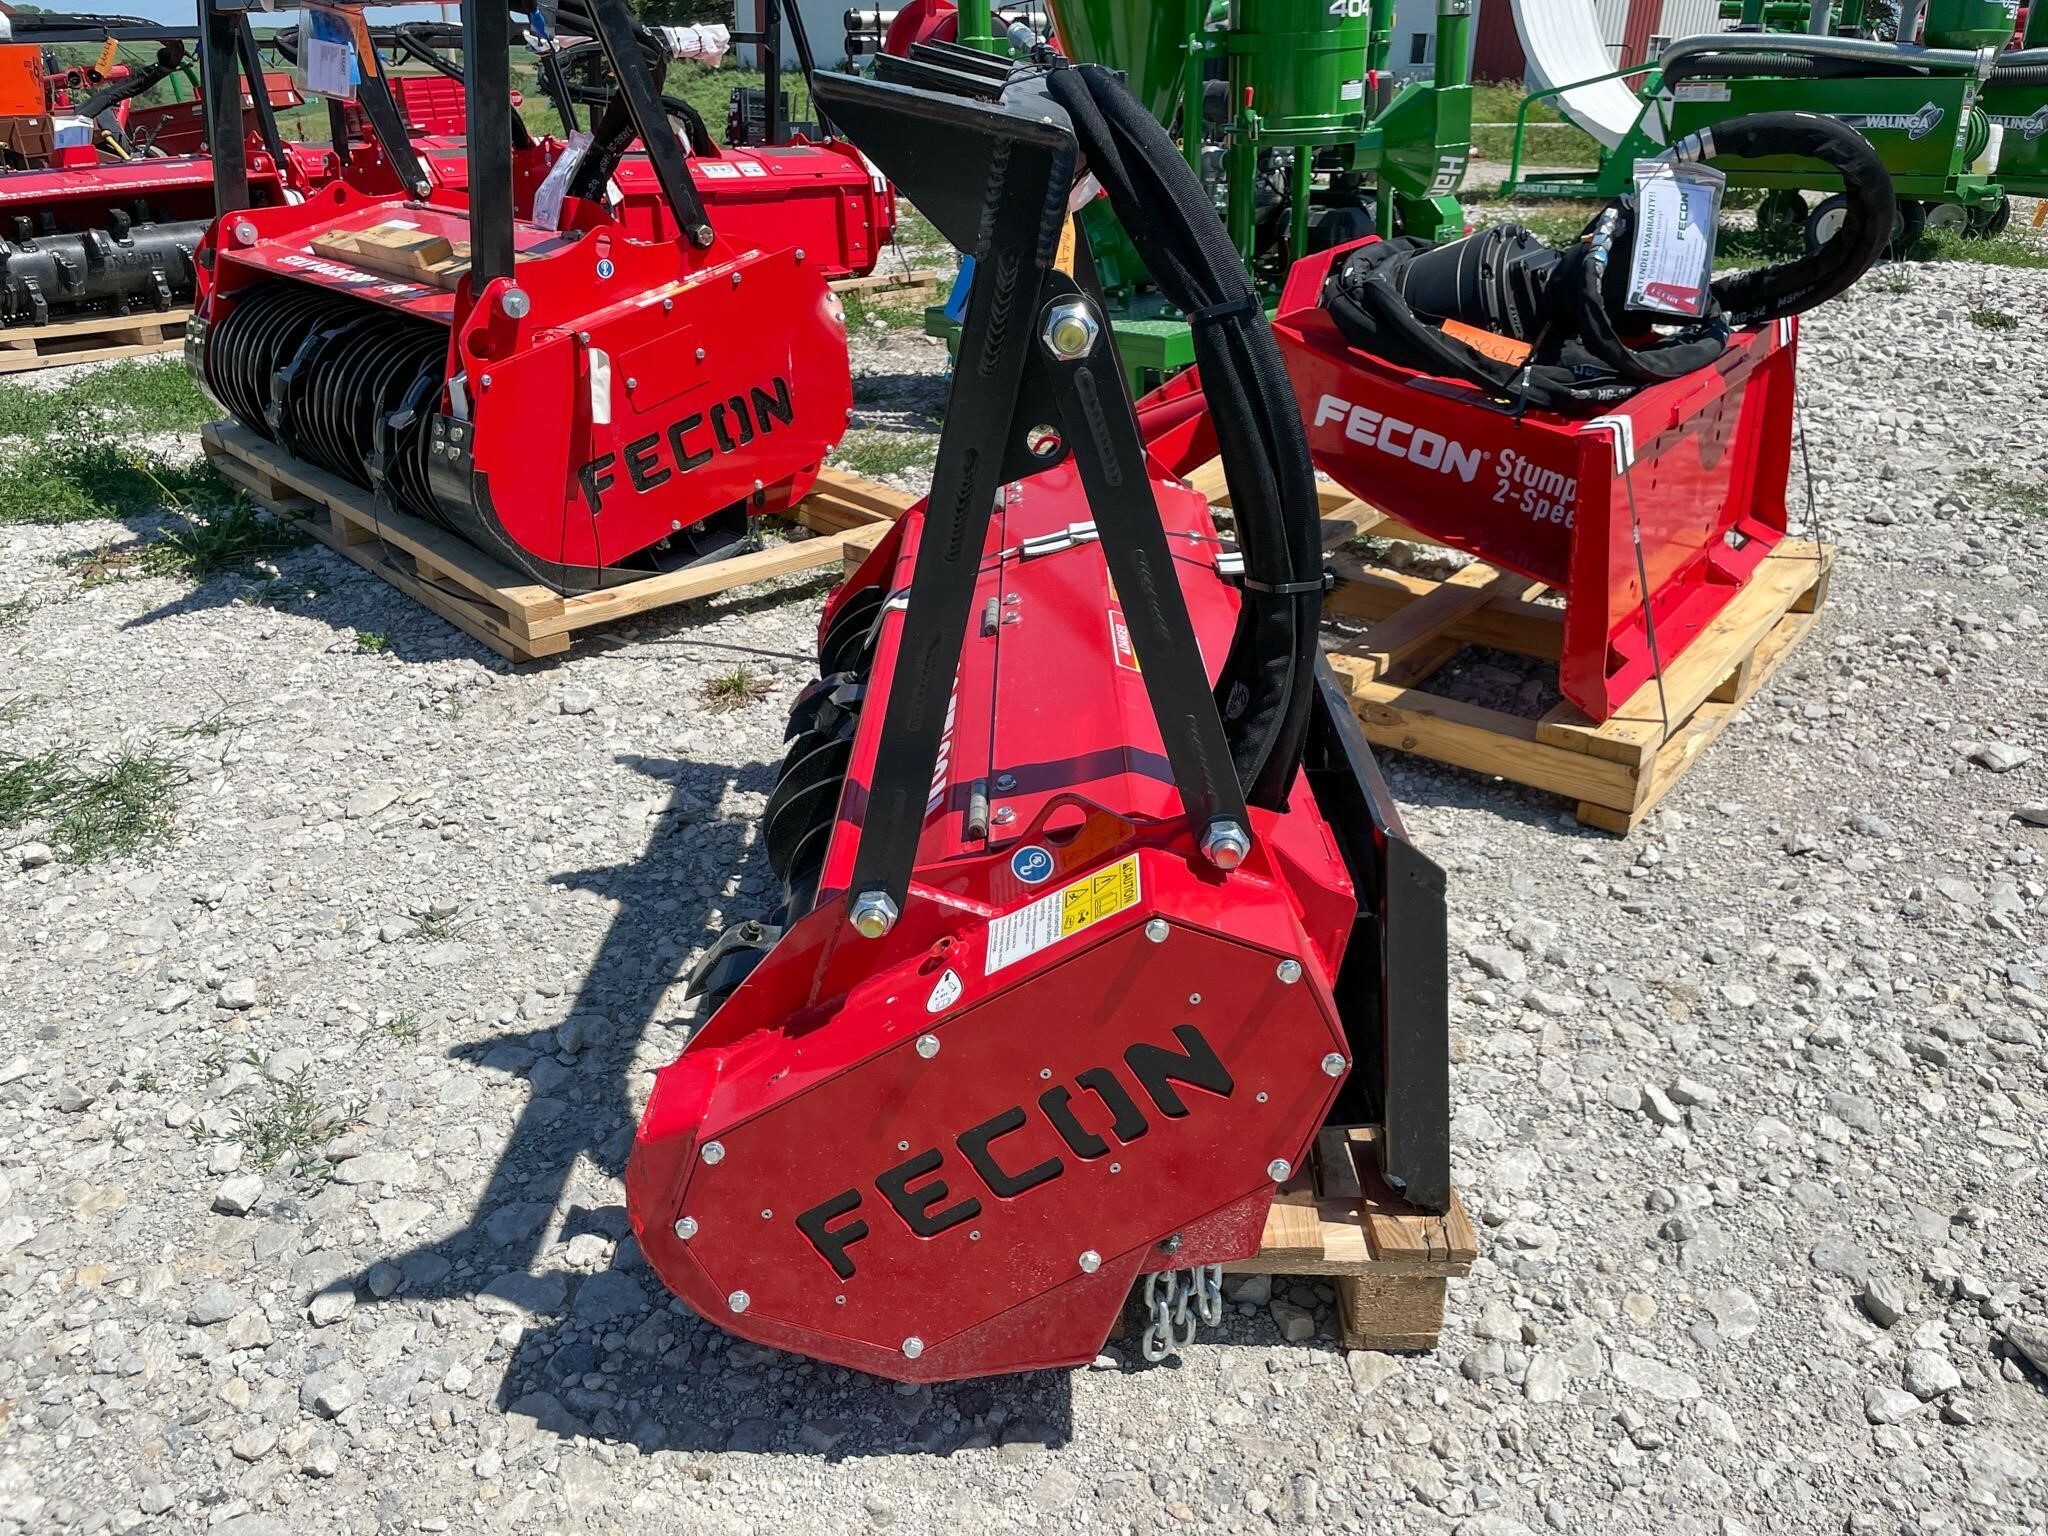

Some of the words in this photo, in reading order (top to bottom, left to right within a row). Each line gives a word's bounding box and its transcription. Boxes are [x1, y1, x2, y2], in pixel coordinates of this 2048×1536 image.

[1329, 0, 1369, 17] 404
[1865, 115, 1929, 129] WALINGA
[1515, 183, 1560, 194] HUSTLER
[1676, 192, 1689, 241] FECON
[1636, 249, 1650, 292] XTENDED
[577, 376, 794, 517] FECON
[1314, 394, 1482, 483] FECON
[1495, 449, 1578, 502] Stump
[1123, 867, 1134, 903] CAUTION
[795, 1024, 1235, 1281] FECON
